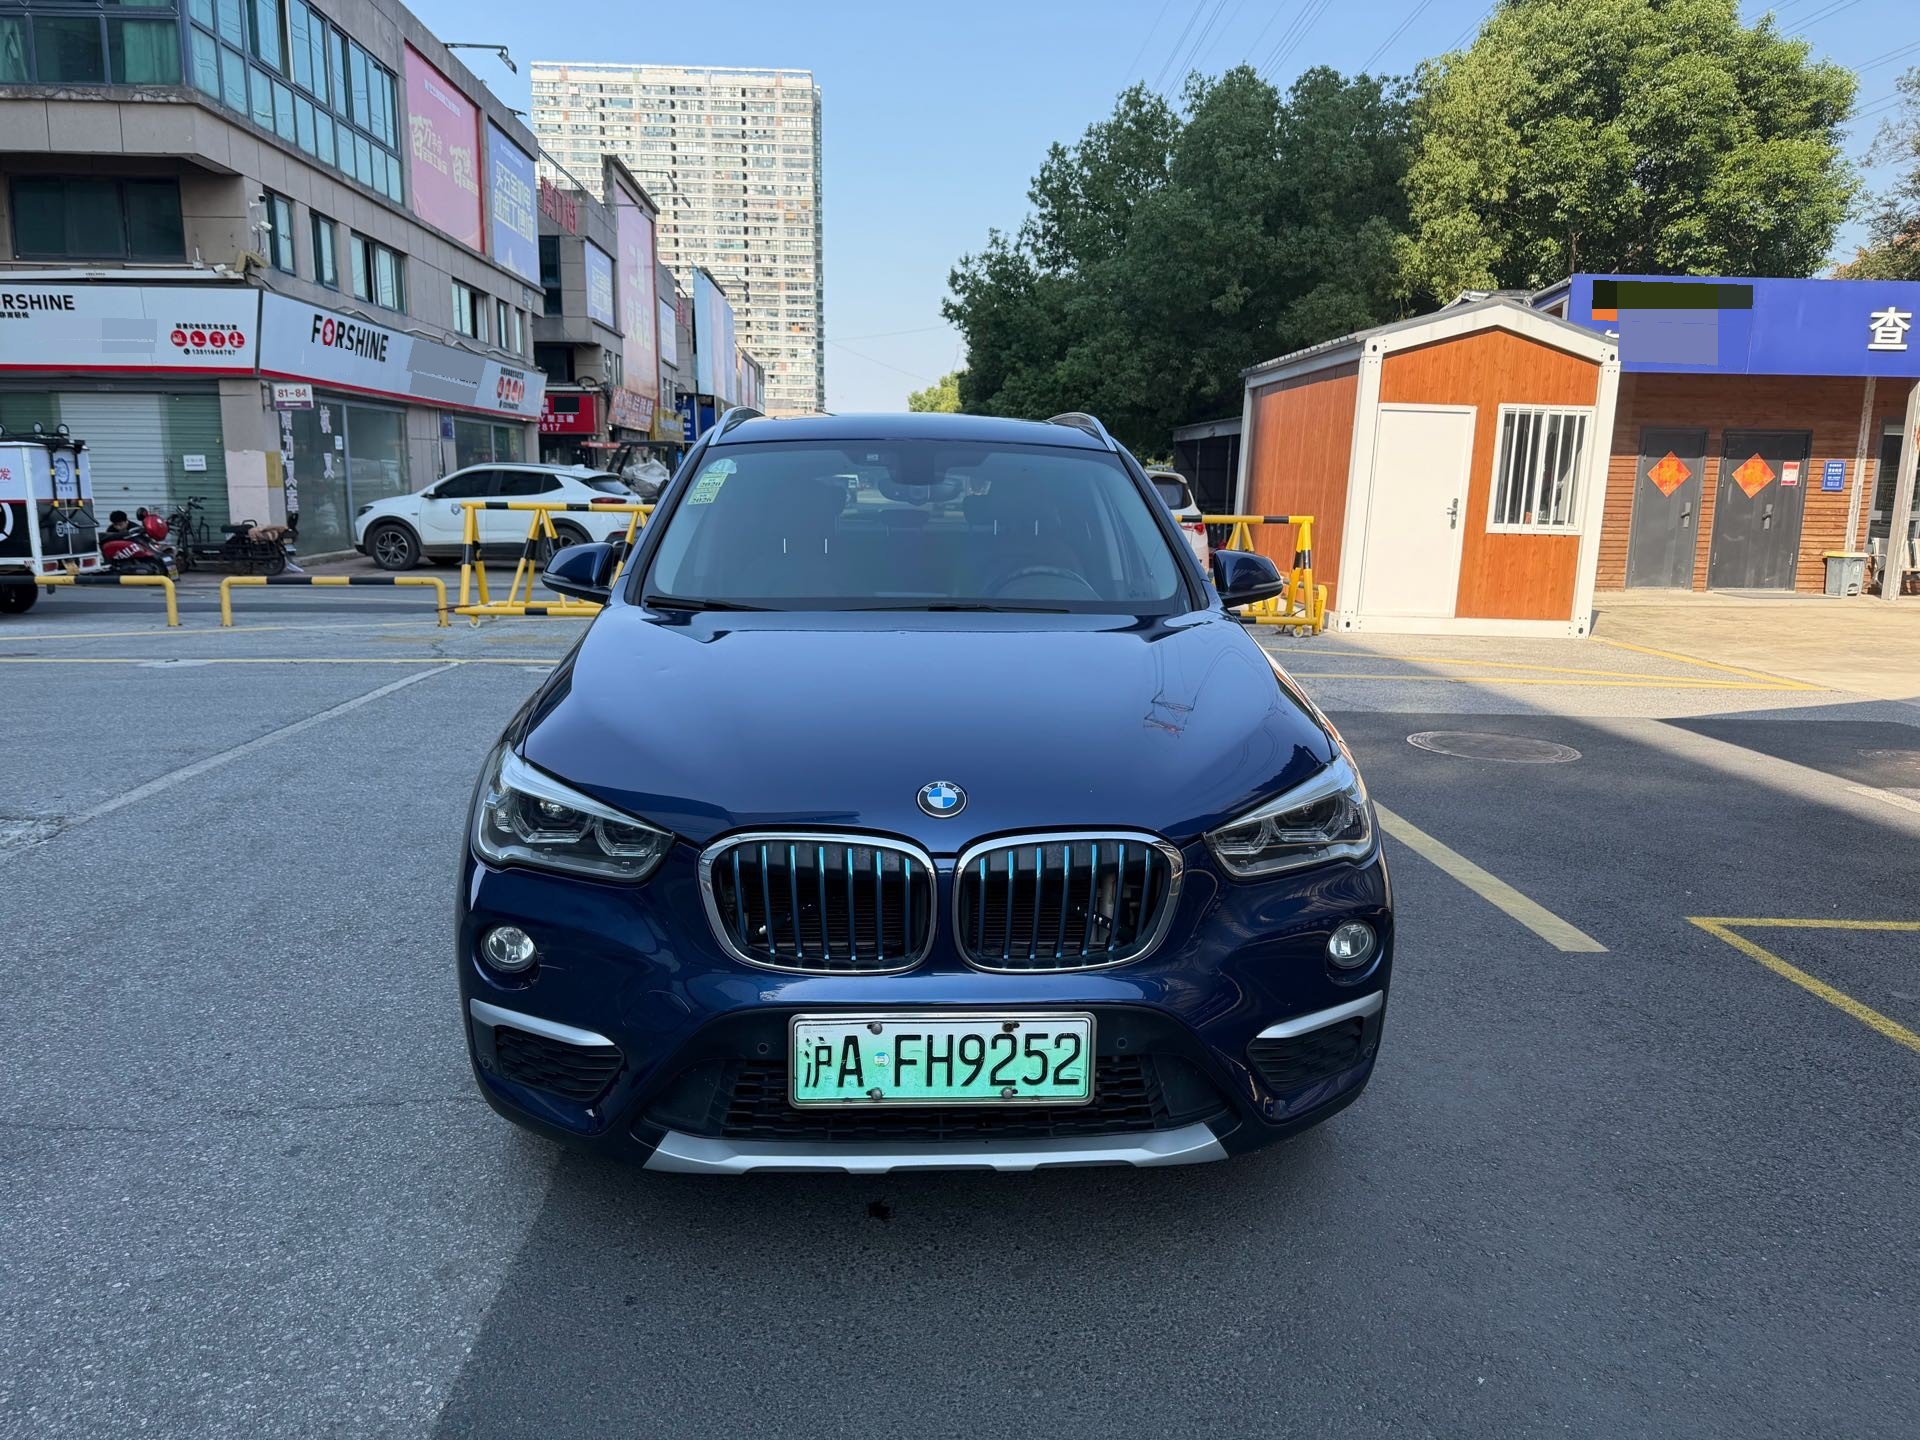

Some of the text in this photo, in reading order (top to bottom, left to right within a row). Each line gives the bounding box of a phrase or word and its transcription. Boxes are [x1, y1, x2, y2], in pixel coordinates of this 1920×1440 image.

[311, 313, 389, 362] FORSHINE
[1867, 306, 1913, 352] 查
[278, 388, 307, 398] 81-84
[800, 1033, 1082, 1088] 沪A FH9252
